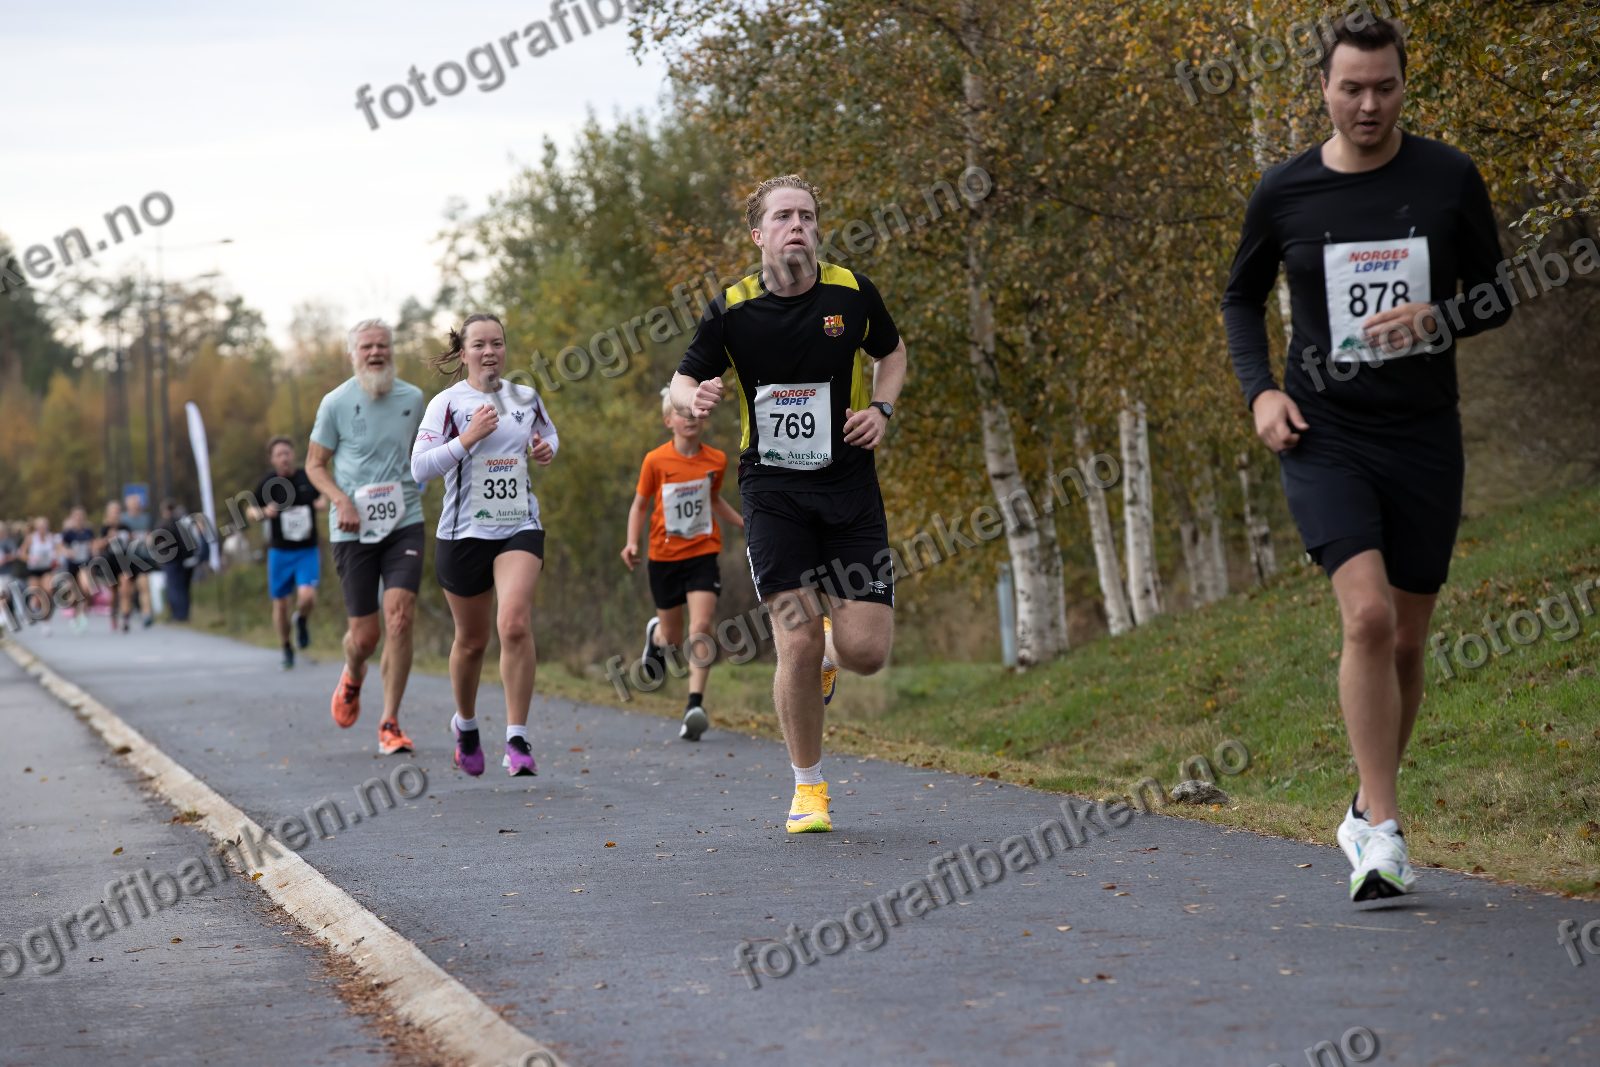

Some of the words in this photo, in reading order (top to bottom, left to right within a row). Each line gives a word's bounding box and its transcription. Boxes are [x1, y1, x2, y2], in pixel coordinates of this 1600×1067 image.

[1348, 248, 1409, 262] NORGES
[1354, 260, 1401, 273] LØPET
[1349, 280, 1411, 317] 878
[772, 389, 816, 398] NORGES
[776, 397, 809, 405] LØPET
[770, 411, 816, 439] 769
[486, 458, 518, 466] NORGES
[787, 450, 829, 461] Aurskog
[483, 478, 518, 500] 333
[367, 501, 396, 521] 299
[675, 500, 702, 519] 105
